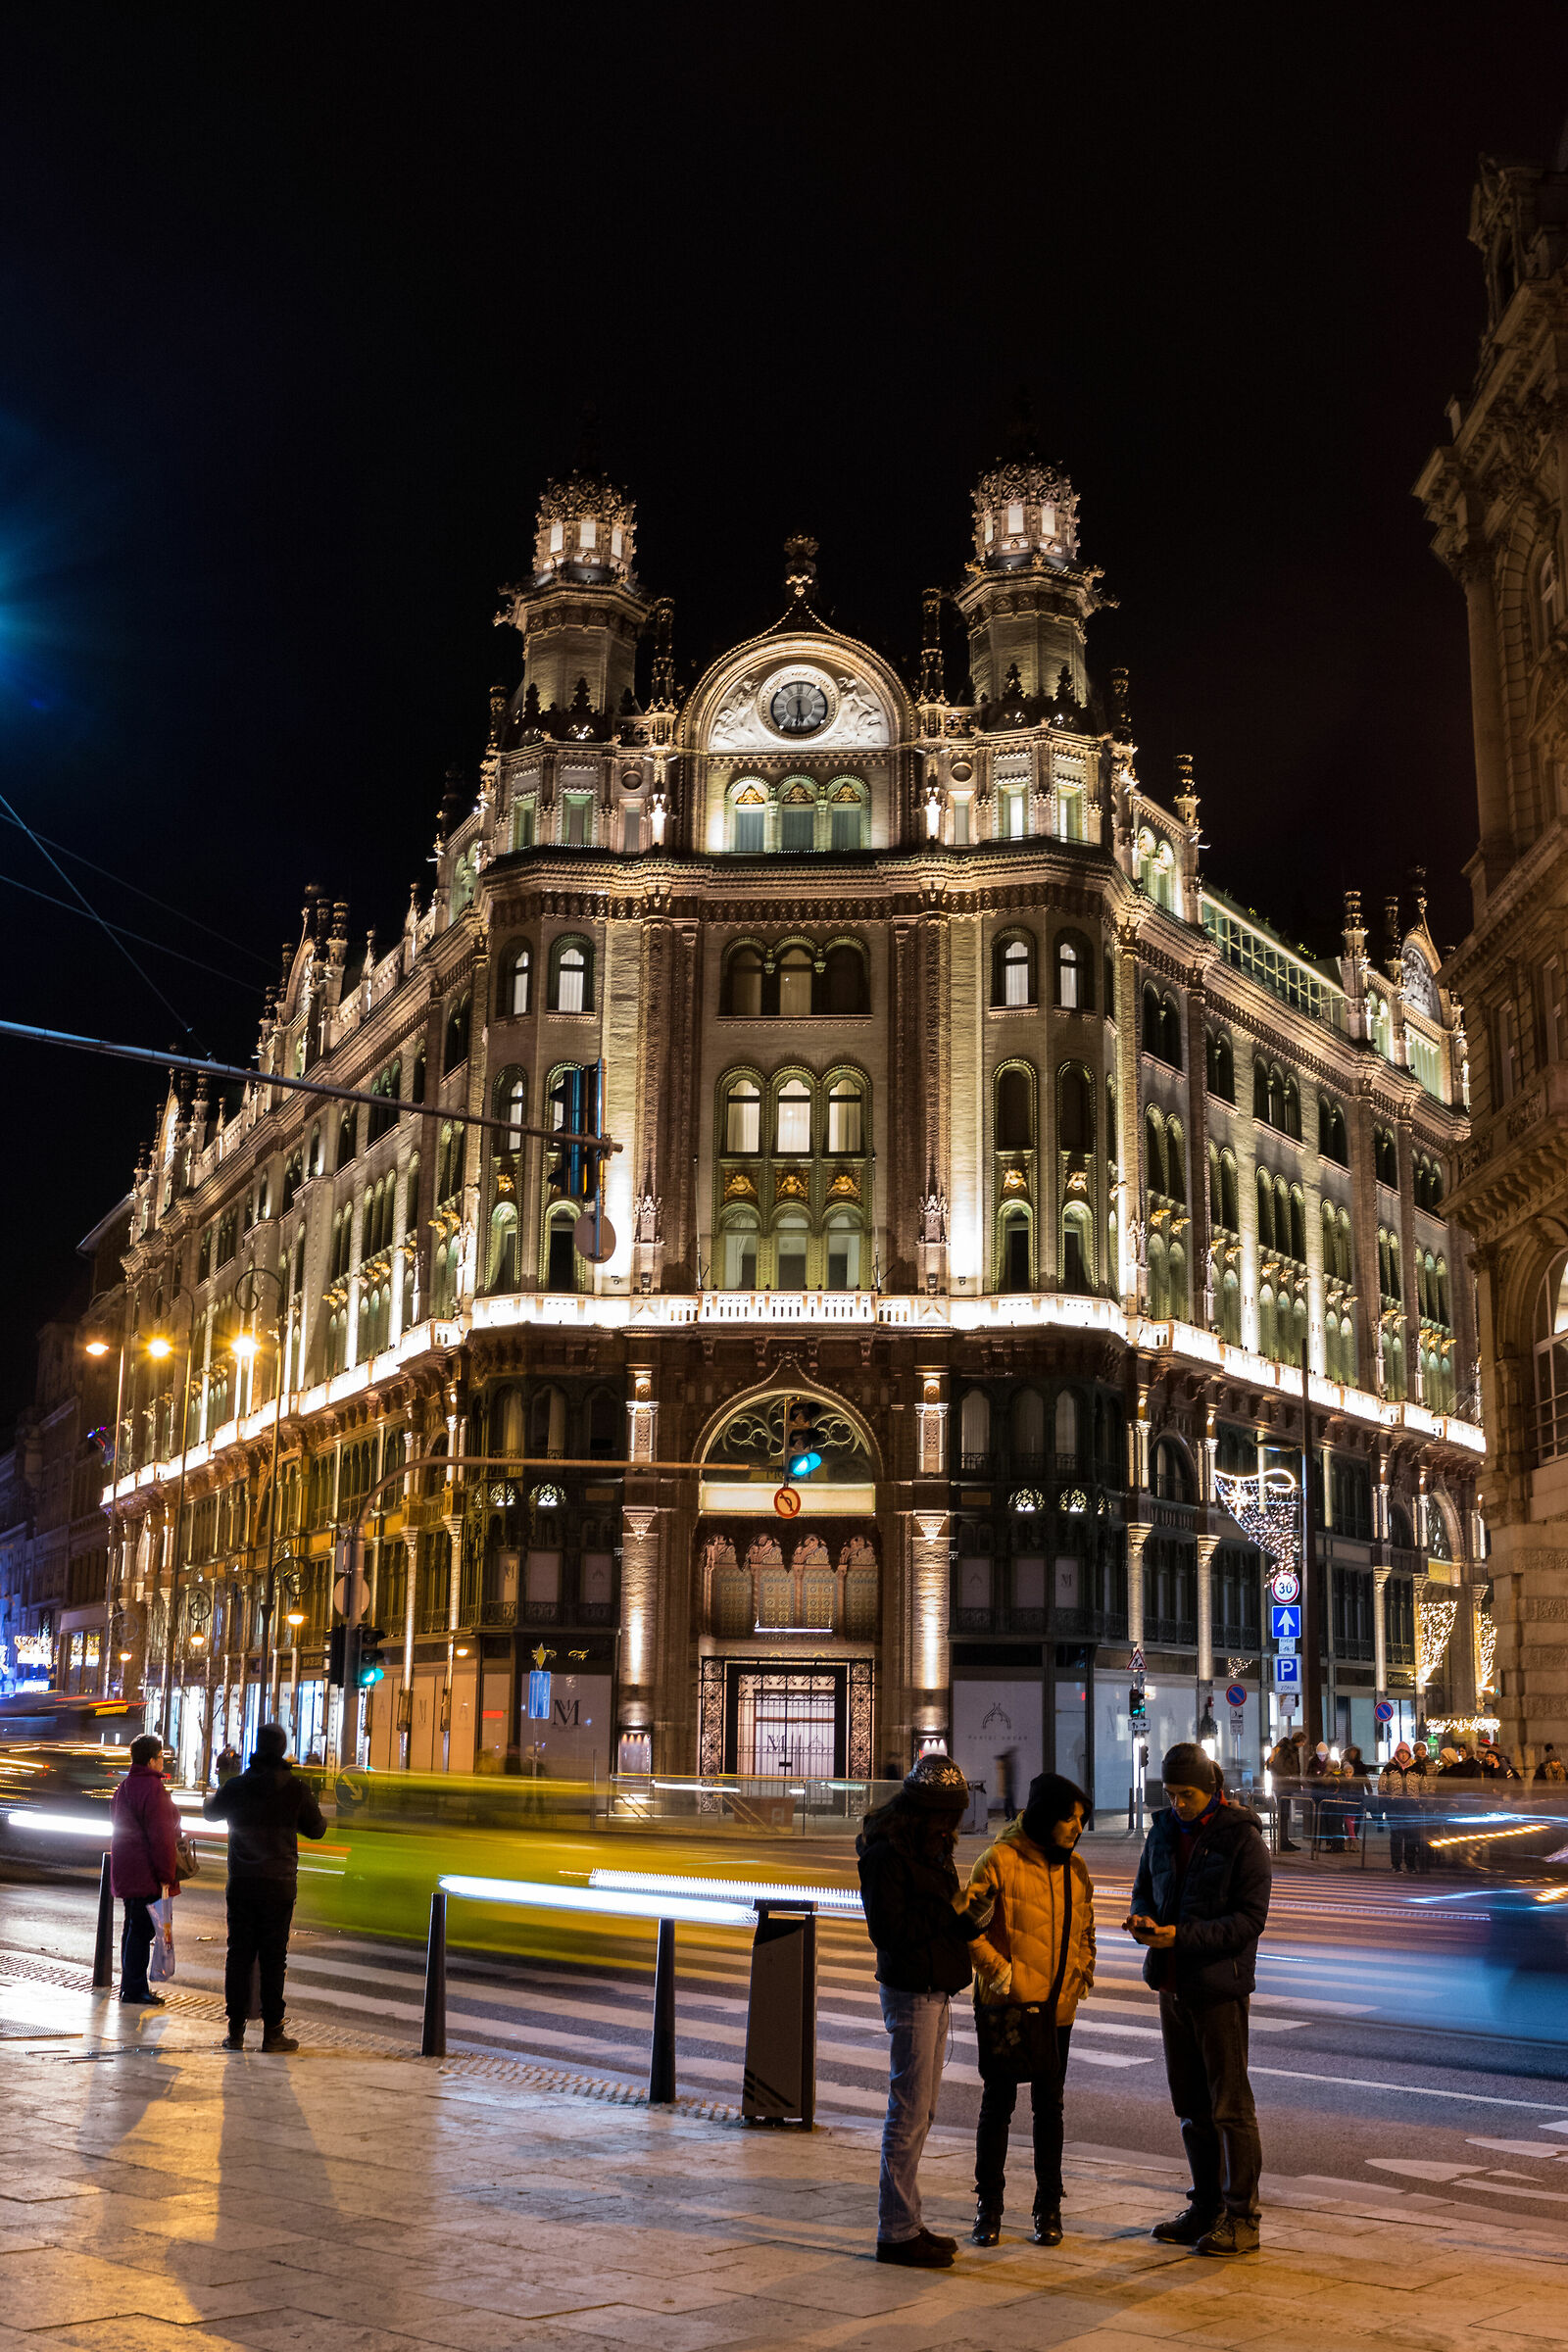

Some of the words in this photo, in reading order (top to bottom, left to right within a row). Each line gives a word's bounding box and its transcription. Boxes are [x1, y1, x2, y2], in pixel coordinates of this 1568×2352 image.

[1279, 1582, 1293, 1594] 30
[1280, 1660, 1294, 1681] P
[552, 1698, 582, 1726] M
